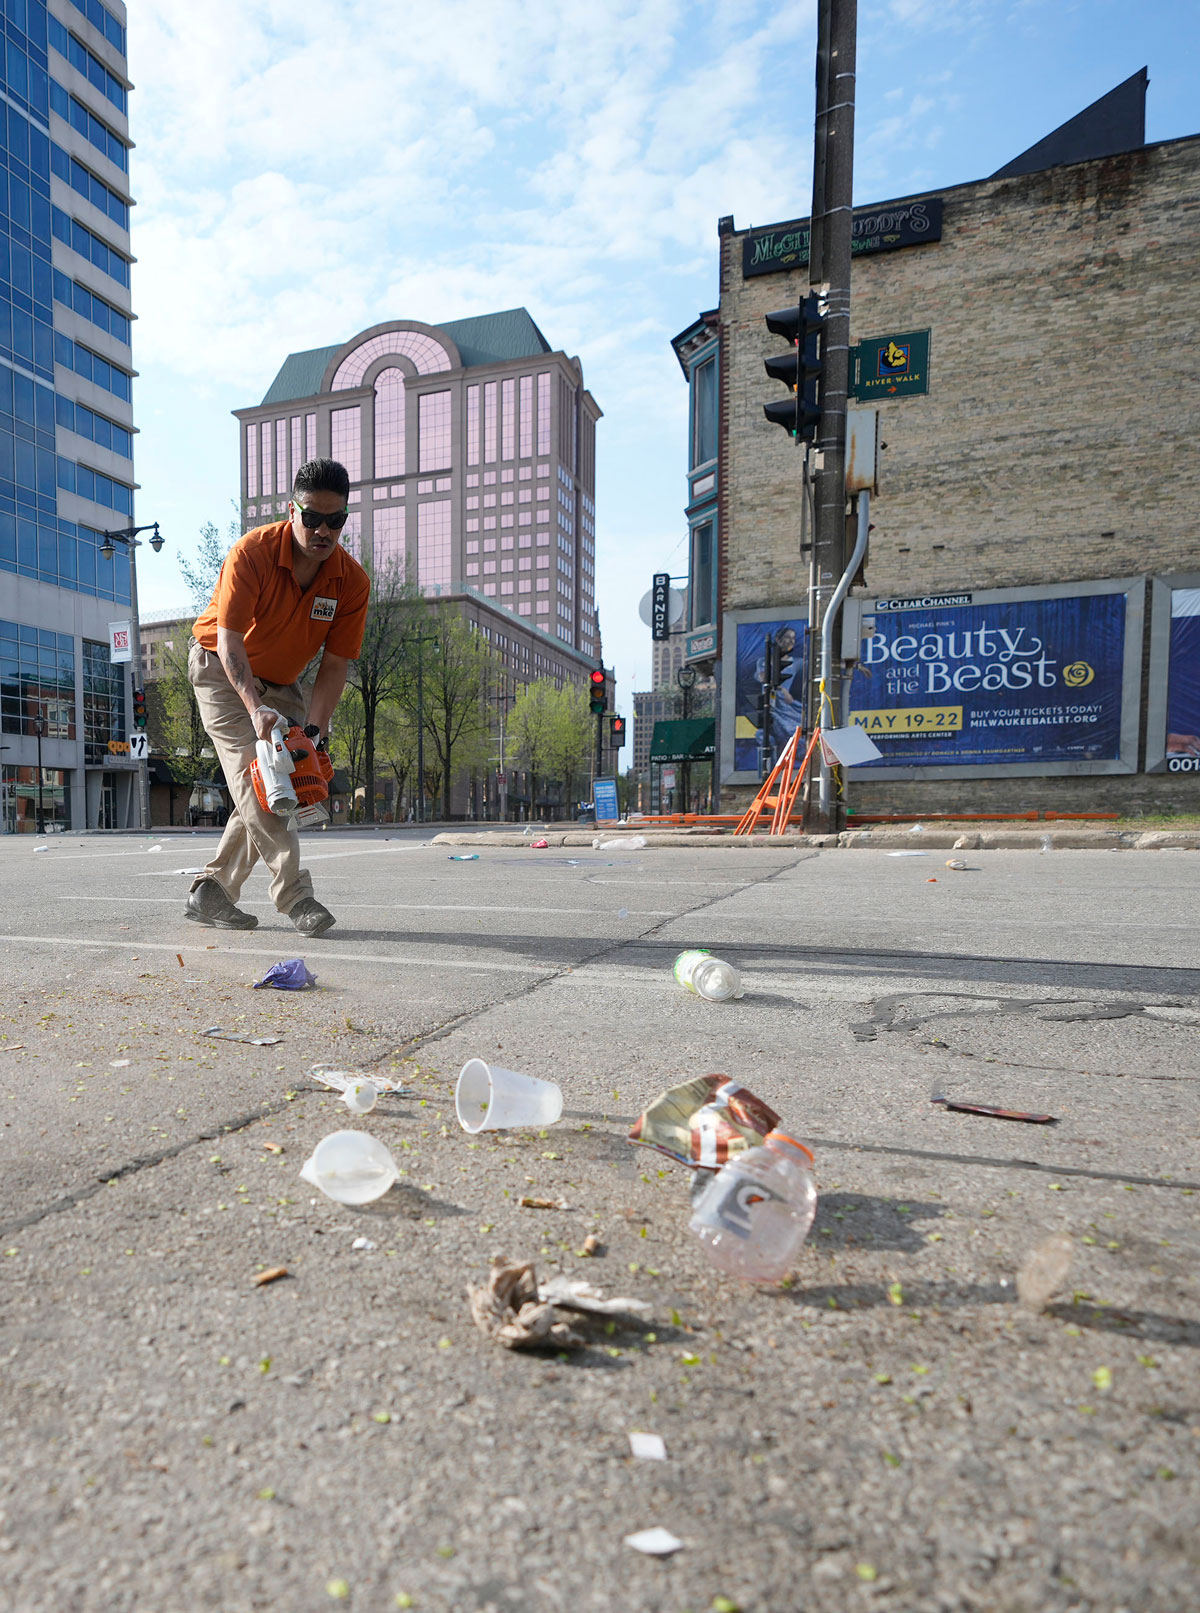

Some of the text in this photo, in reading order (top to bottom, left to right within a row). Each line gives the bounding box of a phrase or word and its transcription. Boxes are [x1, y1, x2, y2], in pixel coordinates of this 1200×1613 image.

[866, 374, 920, 387] RIVER WALK
[863, 621, 1042, 664] Beauty
[886, 664, 919, 679] and
[925, 651, 1057, 693] Beast
[886, 680, 919, 694] the
[970, 705, 1102, 719] BUY YOUR TICKETS TODAY!
[855, 712, 958, 729] MAY 19-22
[970, 715, 1098, 728] MILWAUKEEBALLET.ORG
